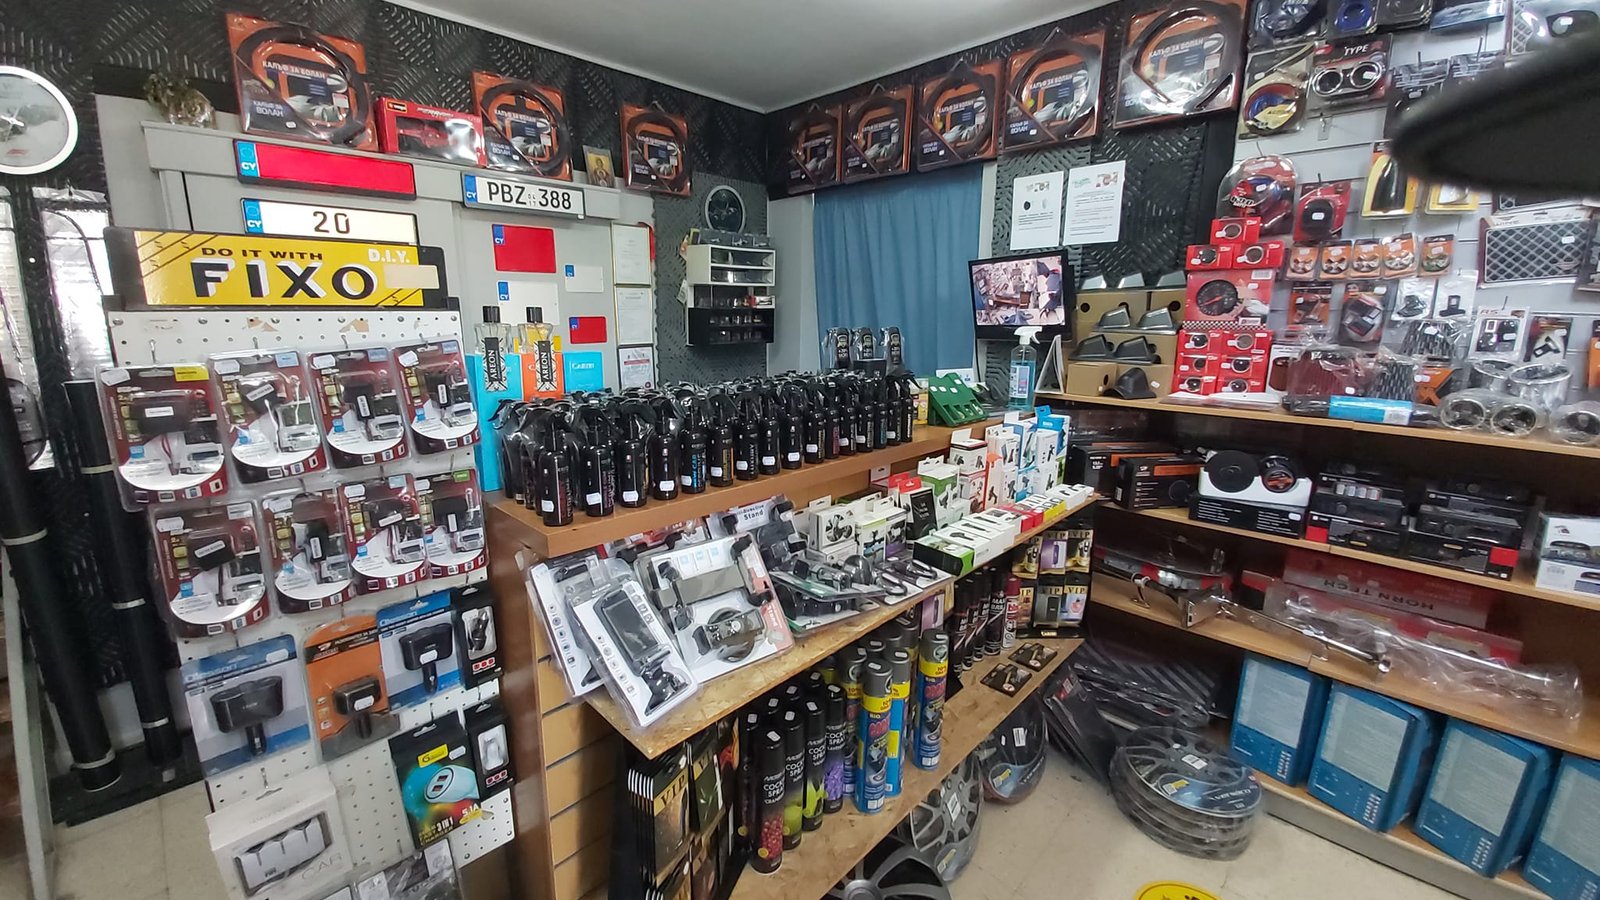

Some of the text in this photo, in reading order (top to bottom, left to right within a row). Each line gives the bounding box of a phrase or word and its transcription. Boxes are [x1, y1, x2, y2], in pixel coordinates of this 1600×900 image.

[1344, 44, 1369, 56] TYPE
[262, 60, 289, 72] КАЛЪФ
[290, 66, 300, 74] ЗА
[256, 106, 284, 117] ВОЛАН
[241, 162, 257, 170] CY
[466, 191, 477, 199] CY
[487, 181, 527, 206] PBZ
[538, 188, 571, 210] 388
[247, 219, 263, 229] CY
[313, 210, 350, 234] 20
[201, 247, 323, 260] DO IT WITH
[368, 248, 410, 263] D.I.Y.
[190, 257, 378, 300] FIXO
[488, 349, 499, 384] AREON
[541, 352, 550, 380] AREON
[743, 509, 764, 521] Stand
[1324, 579, 1434, 611] HORN TECH
[661, 775, 686, 806] VIP
[301, 852, 343, 882] CAR
